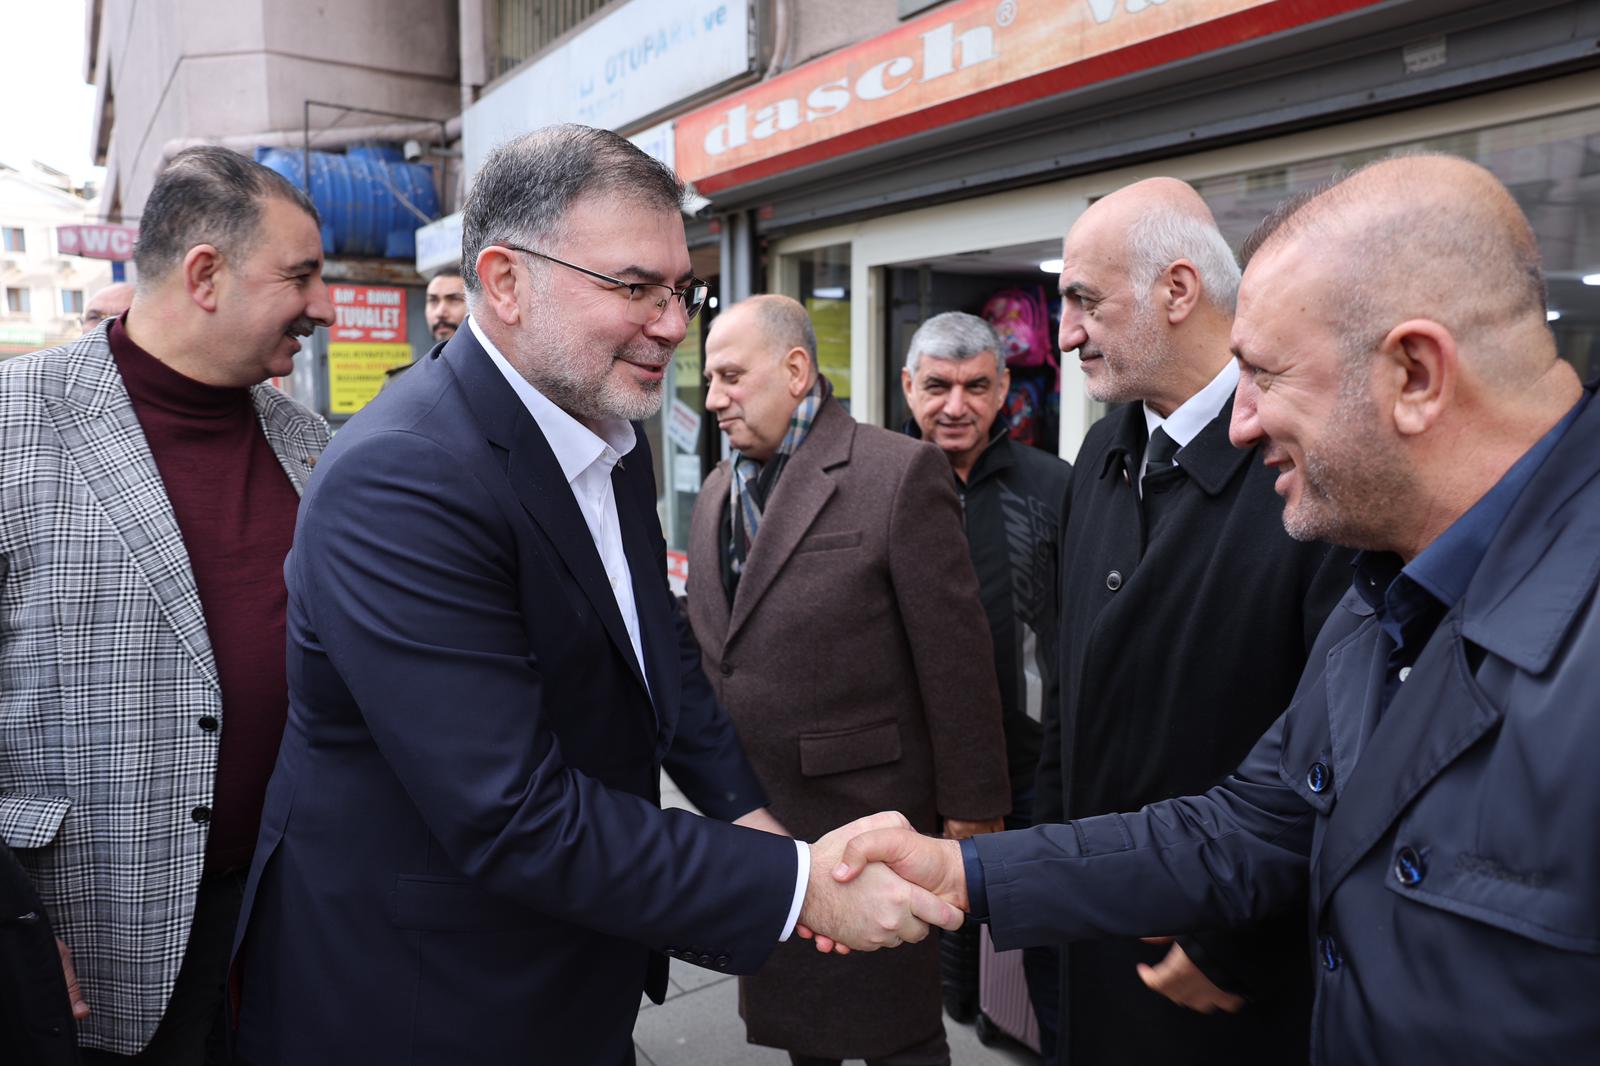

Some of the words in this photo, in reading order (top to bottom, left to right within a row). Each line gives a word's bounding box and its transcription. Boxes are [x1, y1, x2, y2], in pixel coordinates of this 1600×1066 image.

[703, 4, 727, 31] ve
[704, 22, 1000, 156] dasch
[81, 229, 129, 254] WC
[333, 288, 356, 304] BAY
[366, 290, 401, 305] BAYAN
[335, 306, 400, 328] TUVALET
[997, 479, 1034, 620] TOMMY
